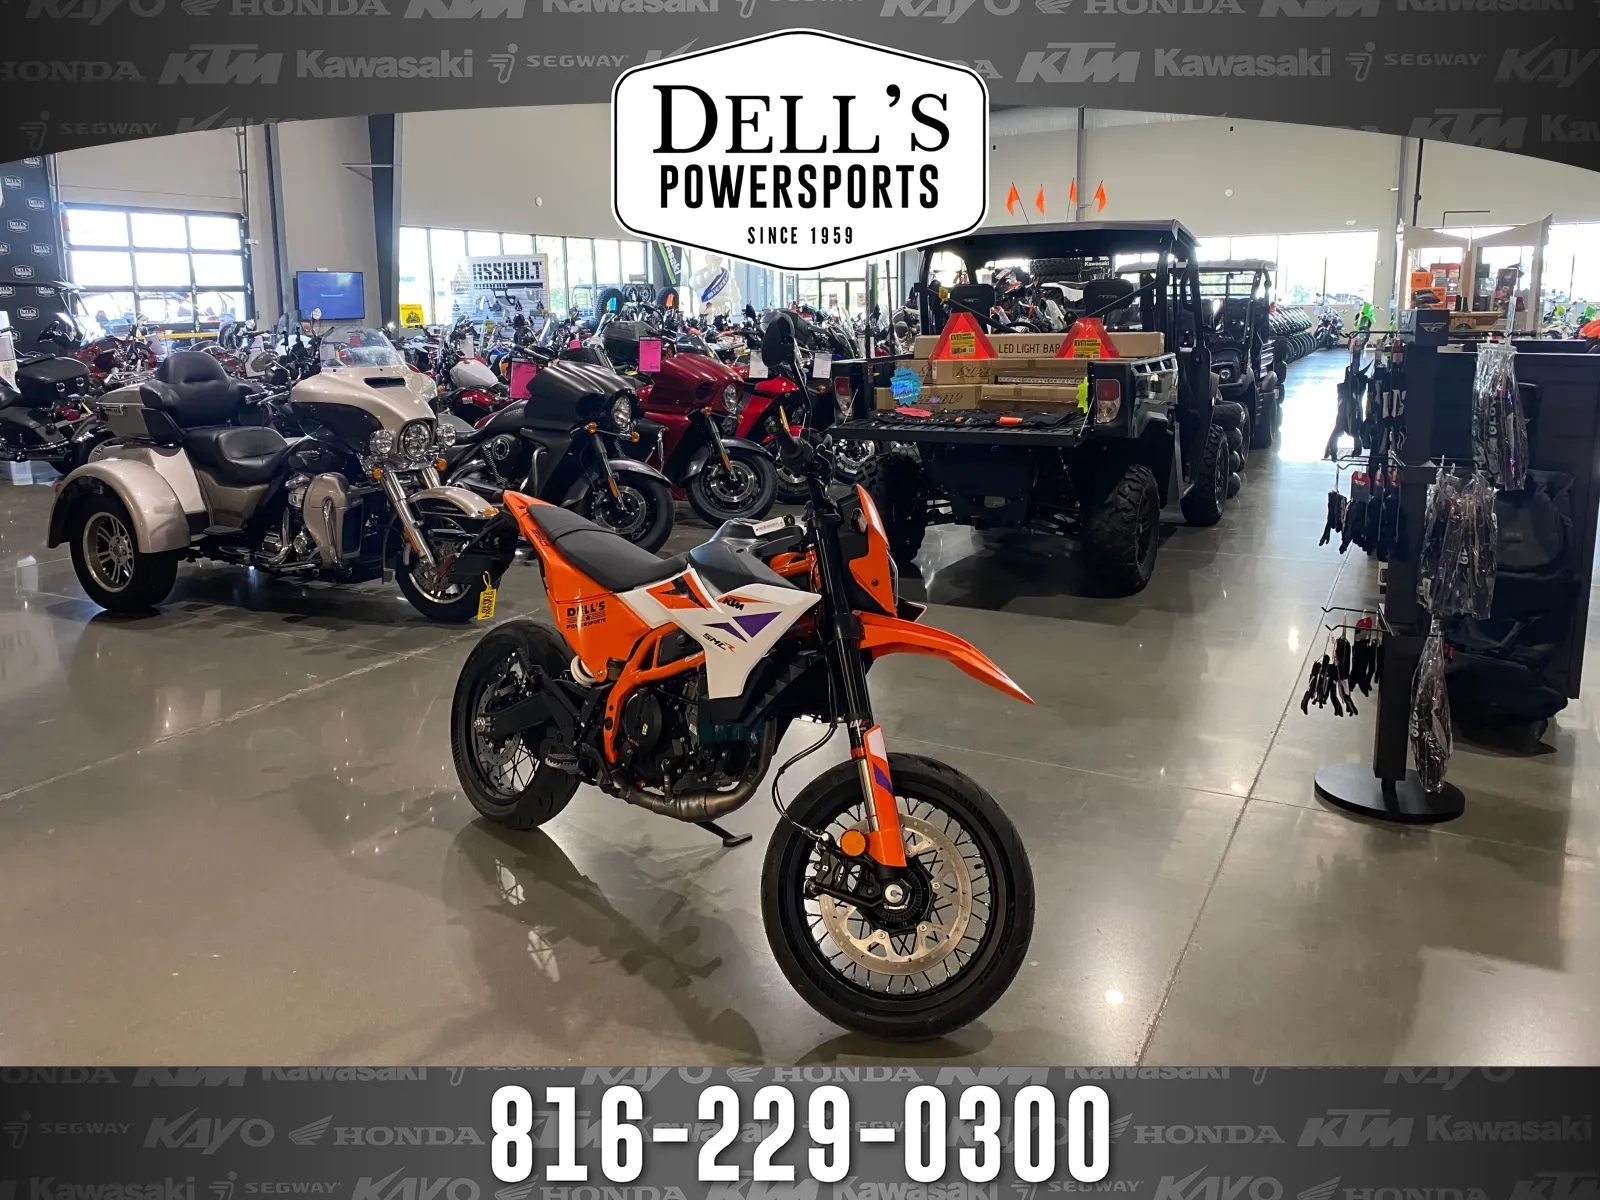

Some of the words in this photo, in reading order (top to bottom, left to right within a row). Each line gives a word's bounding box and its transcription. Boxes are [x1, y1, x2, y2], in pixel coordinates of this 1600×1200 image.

[473, 261, 542, 281] ASSAULT
[998, 343, 1014, 354] LED
[1017, 343, 1041, 354] LIGHT
[722, 597, 745, 611] KTM
